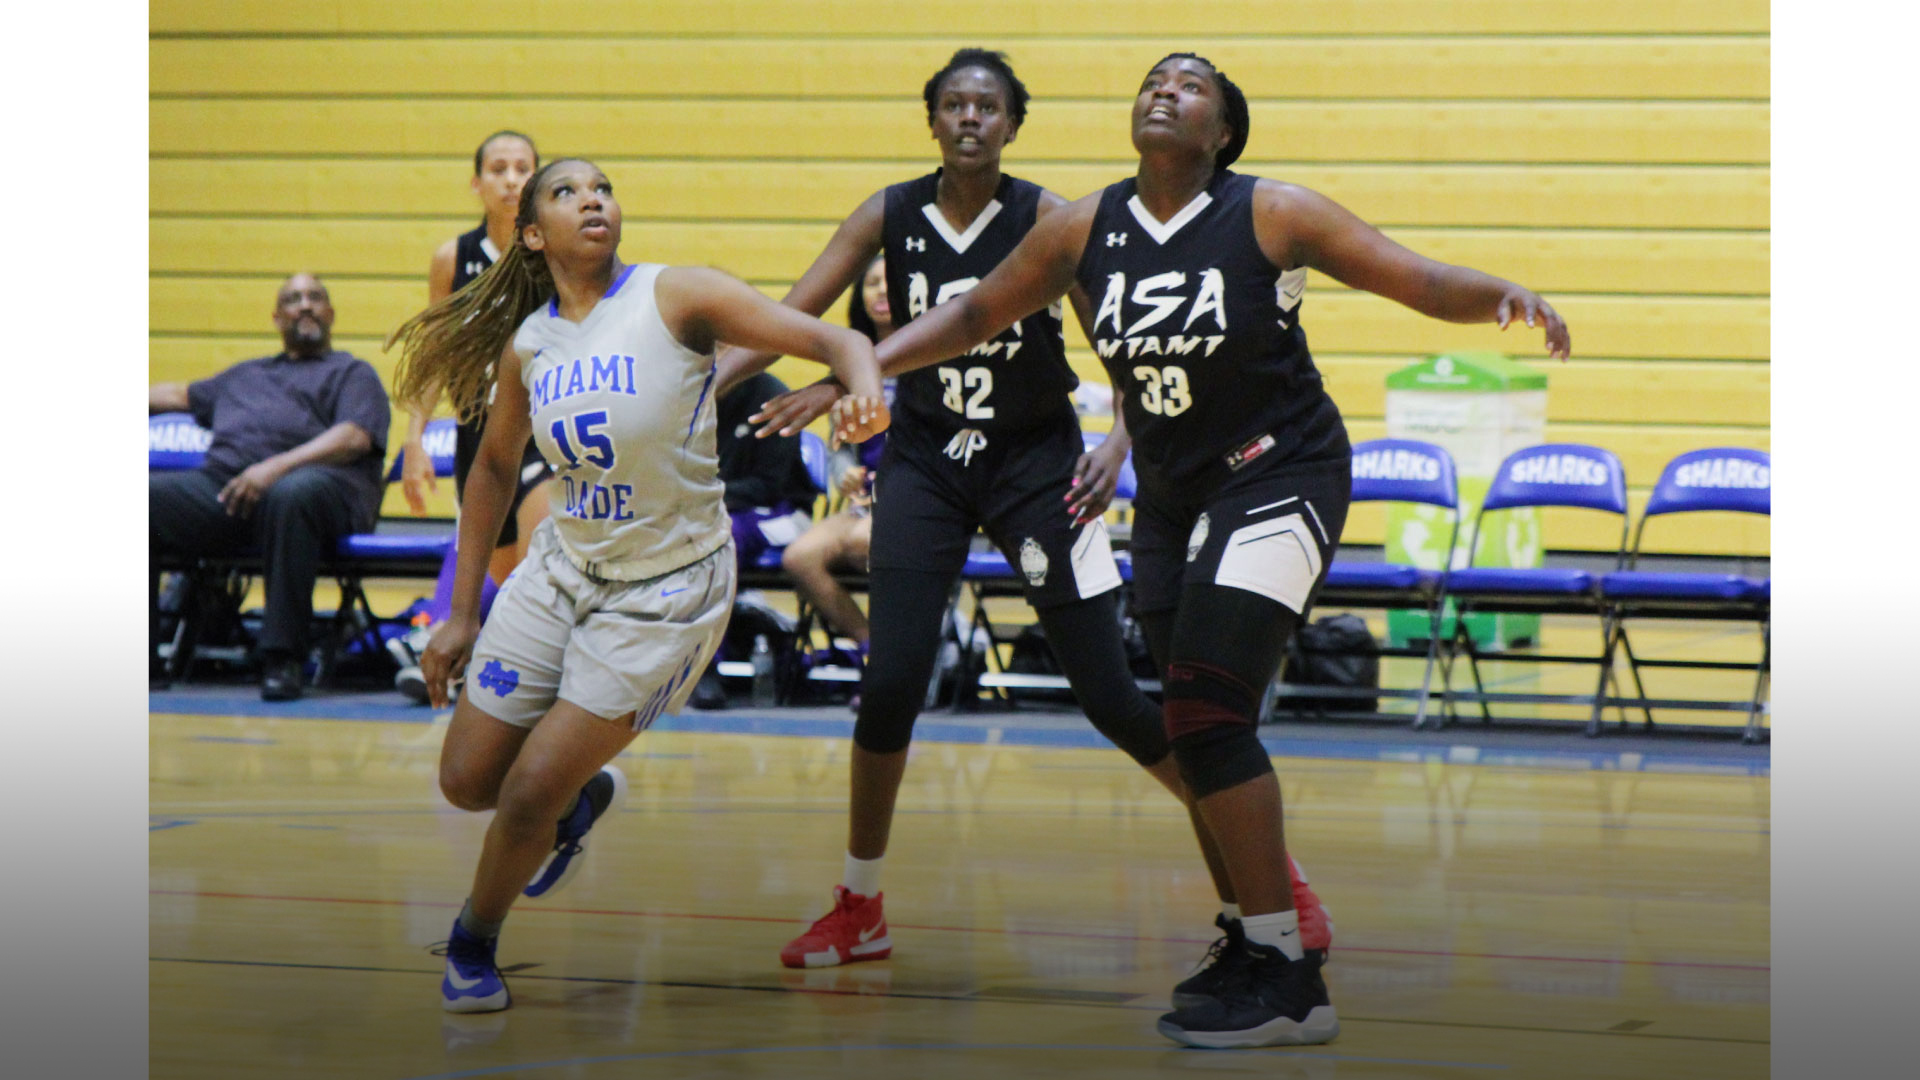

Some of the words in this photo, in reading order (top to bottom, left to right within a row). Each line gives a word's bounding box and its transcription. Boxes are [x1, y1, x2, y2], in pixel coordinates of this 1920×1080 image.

[1093, 268, 1227, 338] ASA
[532, 354, 638, 416] MIAMI
[1133, 365, 1193, 417] 33
[149, 421, 214, 452] HARKS
[550, 409, 616, 472] 15
[1511, 454, 1609, 486] SHARKS
[1674, 458, 1770, 489] SHARKS
[562, 475, 635, 521] DADE
